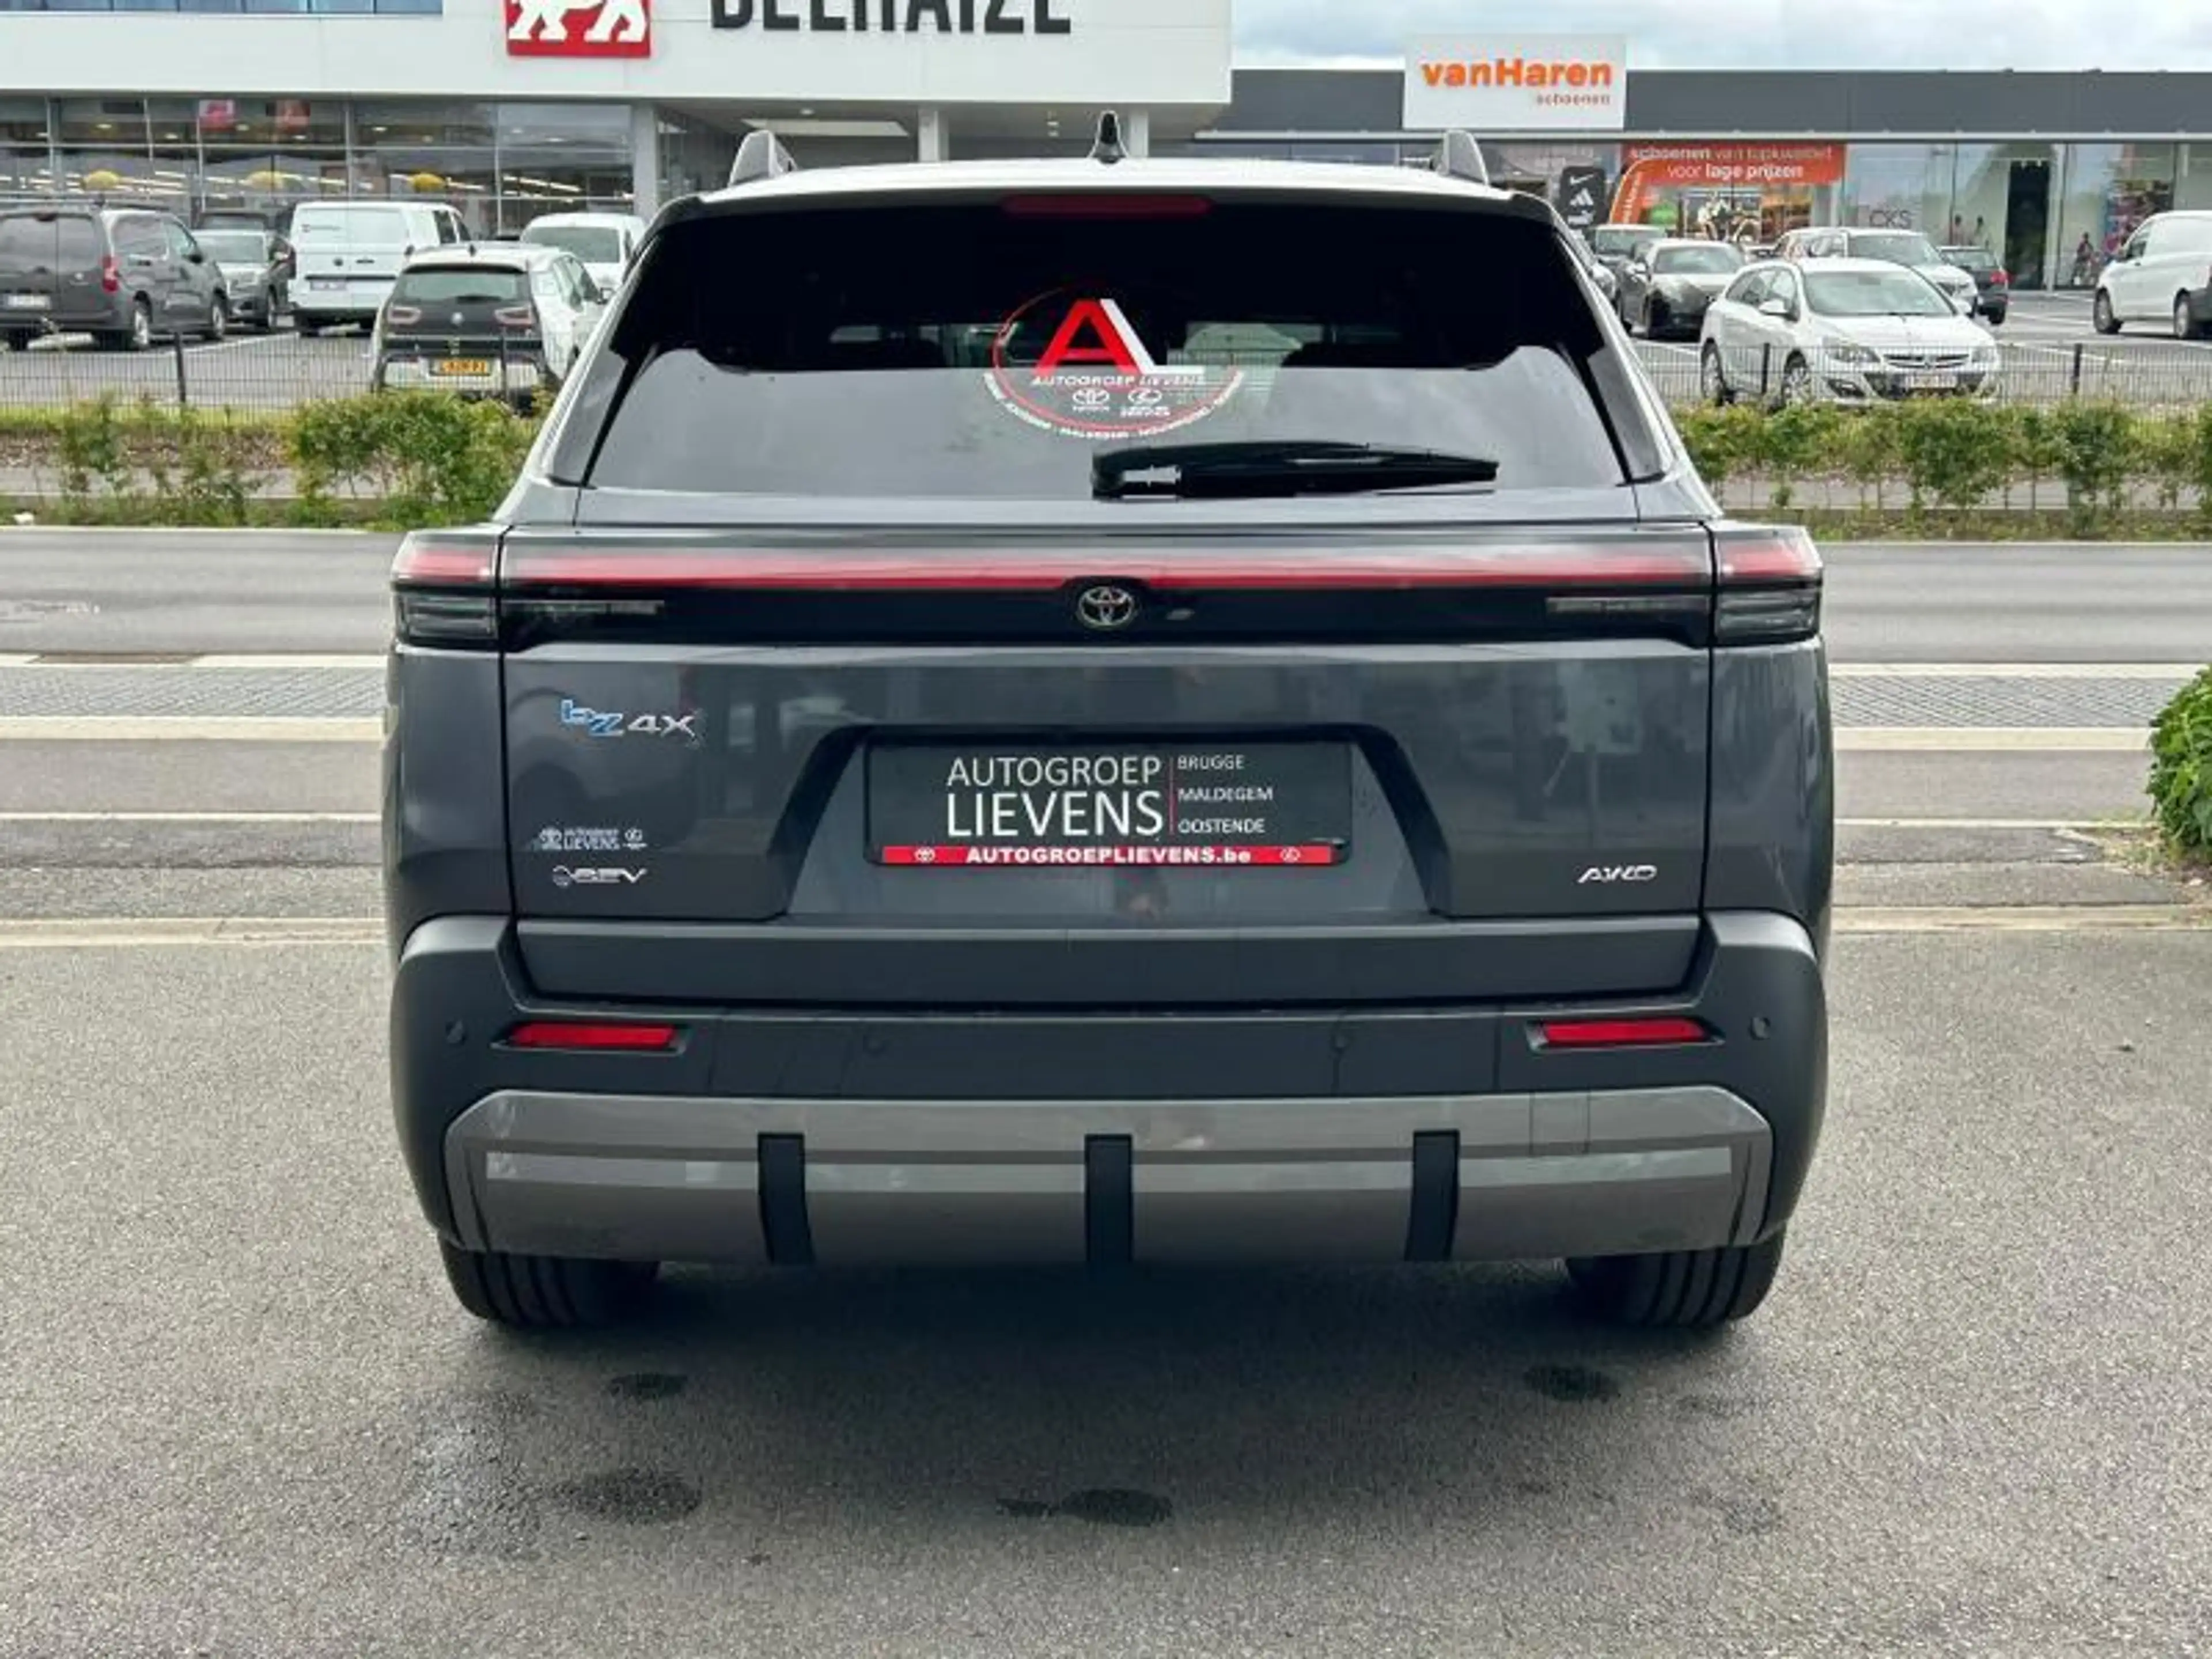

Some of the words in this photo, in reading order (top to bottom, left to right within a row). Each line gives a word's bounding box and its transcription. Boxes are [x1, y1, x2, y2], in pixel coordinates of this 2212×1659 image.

[1421, 58, 1612, 87] vanHaren
[1666, 164, 1702, 178] voor
[1706, 164, 1744, 181] lage
[1746, 164, 1805, 183] prijzen
[1031, 376, 1135, 386] AUTOGROEP
[948, 757, 1161, 787] AUTOGROEP
[1178, 756, 1245, 770] BRUGGE
[1178, 787, 1274, 802] MALDEGEM
[947, 791, 1164, 837] LIEVENS
[1178, 819, 1266, 834] OOSTENDE
[966, 846, 1252, 864] AUTOGROEPLIEVENS.be
[1578, 865, 1657, 884] AWD
